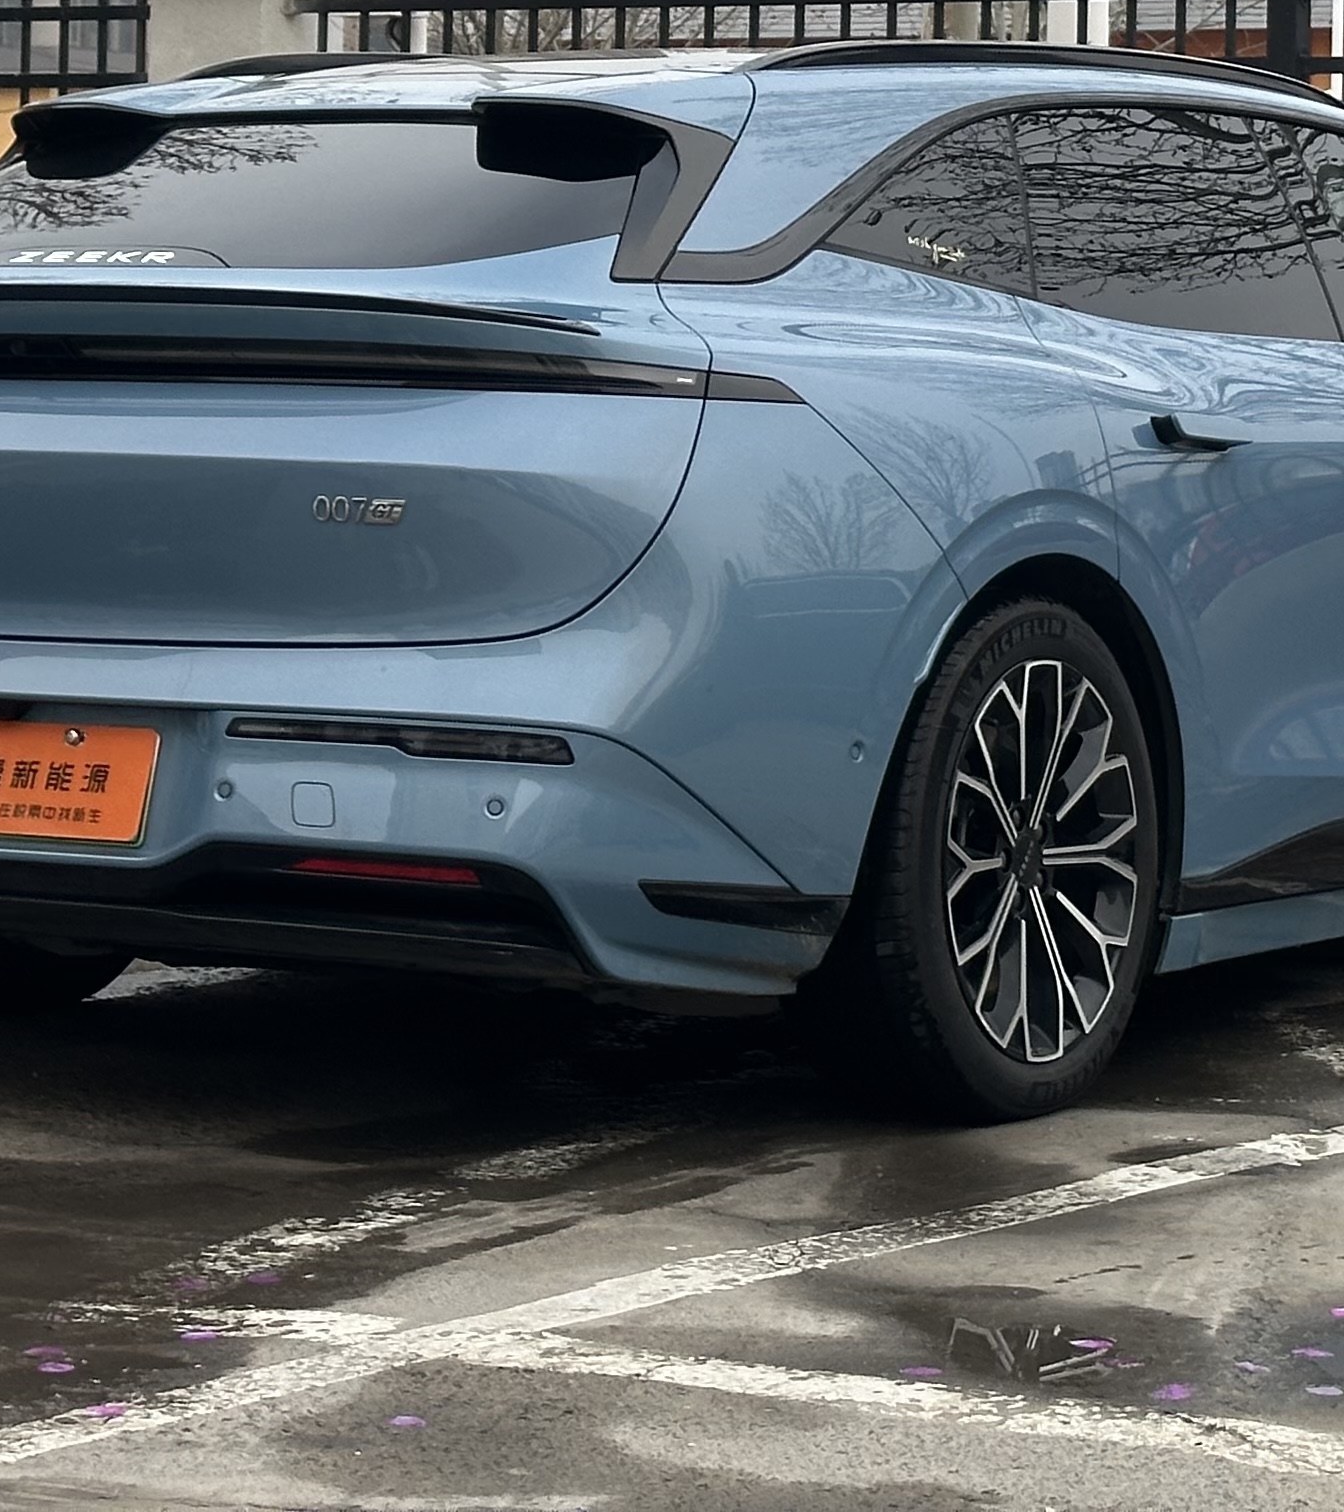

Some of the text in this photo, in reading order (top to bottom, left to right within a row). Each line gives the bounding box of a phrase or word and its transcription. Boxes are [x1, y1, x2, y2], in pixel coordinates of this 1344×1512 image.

[9, 250, 176, 264] ZEEKR
[312, 495, 367, 522] 007
[980, 618, 1065, 676] MICHELIN
